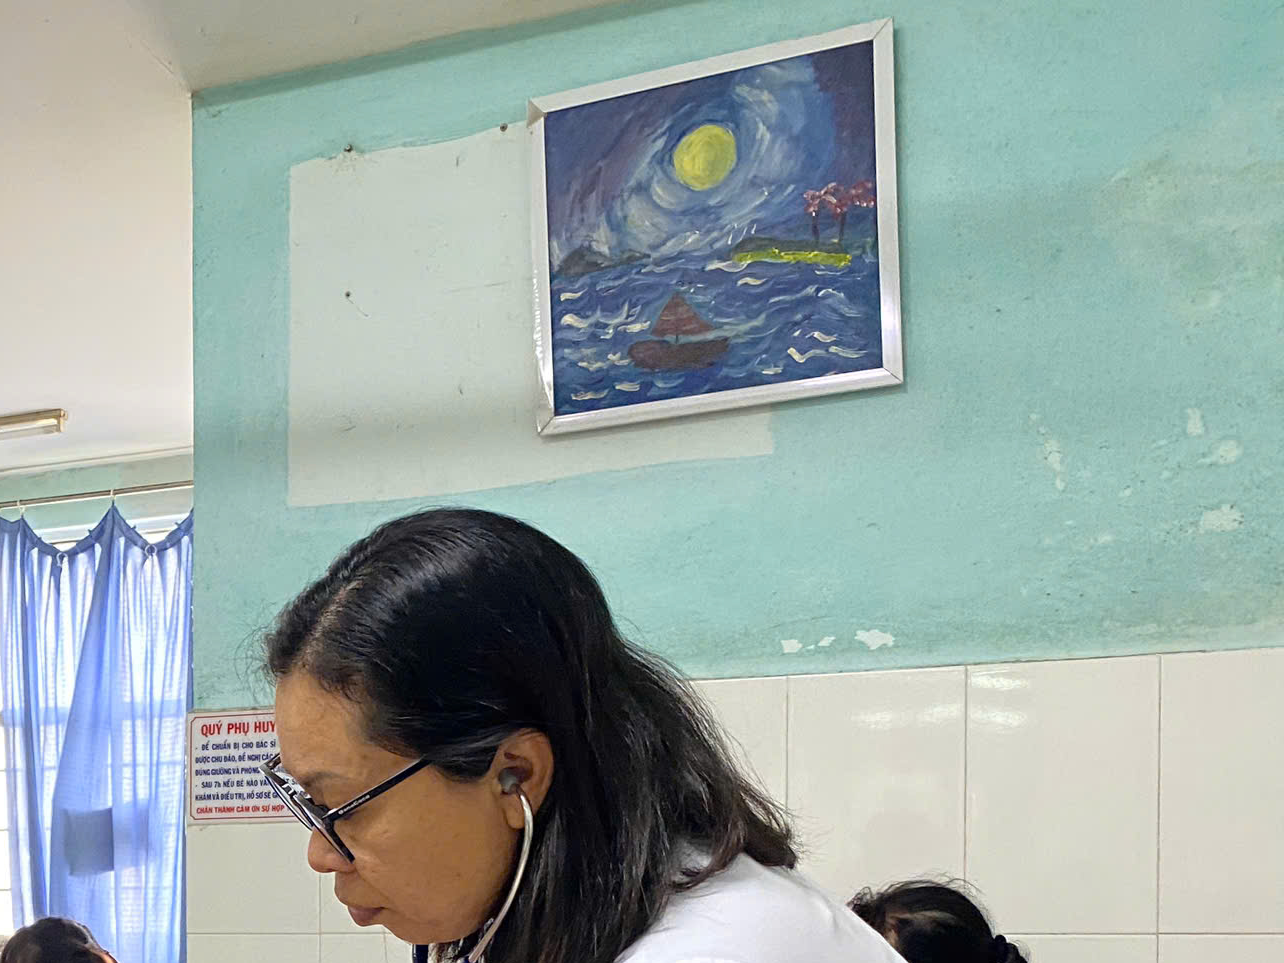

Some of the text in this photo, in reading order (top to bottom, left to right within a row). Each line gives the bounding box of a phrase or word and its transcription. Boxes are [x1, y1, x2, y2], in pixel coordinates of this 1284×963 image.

[201, 720, 276, 738] QUÝ PHỤ HUY
[211, 755, 223, 763] CHU
